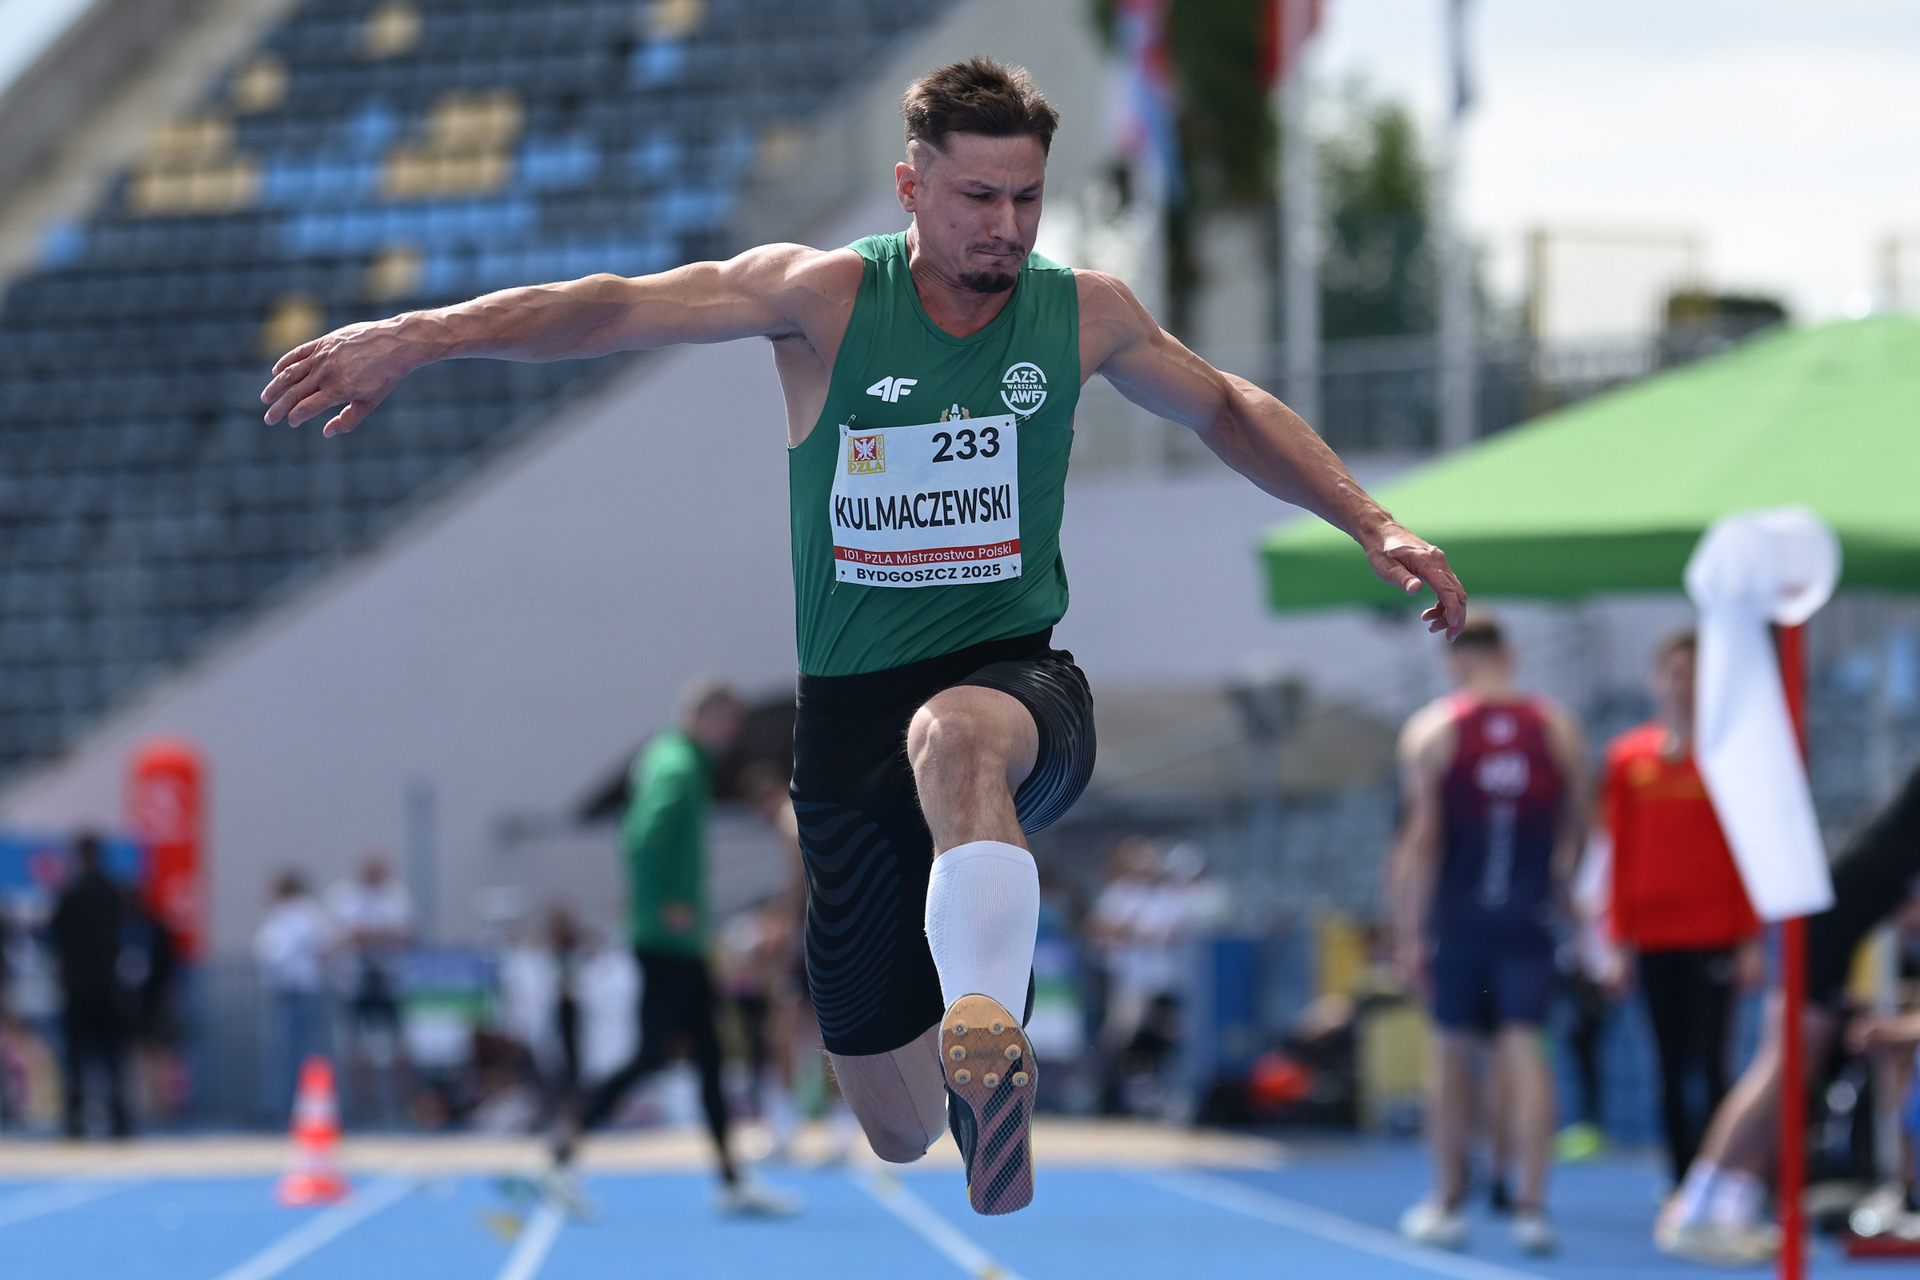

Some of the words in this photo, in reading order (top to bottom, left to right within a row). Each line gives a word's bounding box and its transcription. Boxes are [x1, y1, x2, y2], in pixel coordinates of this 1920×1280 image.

[1010, 370, 1038, 383] AZS
[866, 375, 918, 403] 4F
[1010, 390, 1040, 403] AWF
[931, 426, 1001, 463] 233
[849, 460, 884, 473] PZLA
[835, 484, 1011, 531] KULMACZEWSKI
[843, 549, 862, 561] 101.
[864, 553, 893, 564] PZLA
[896, 550, 975, 564] Mistrzostwa
[978, 542, 1012, 558] Polski
[856, 567, 958, 583] BYDGOSZCZ
[961, 563, 1002, 579] 2025
